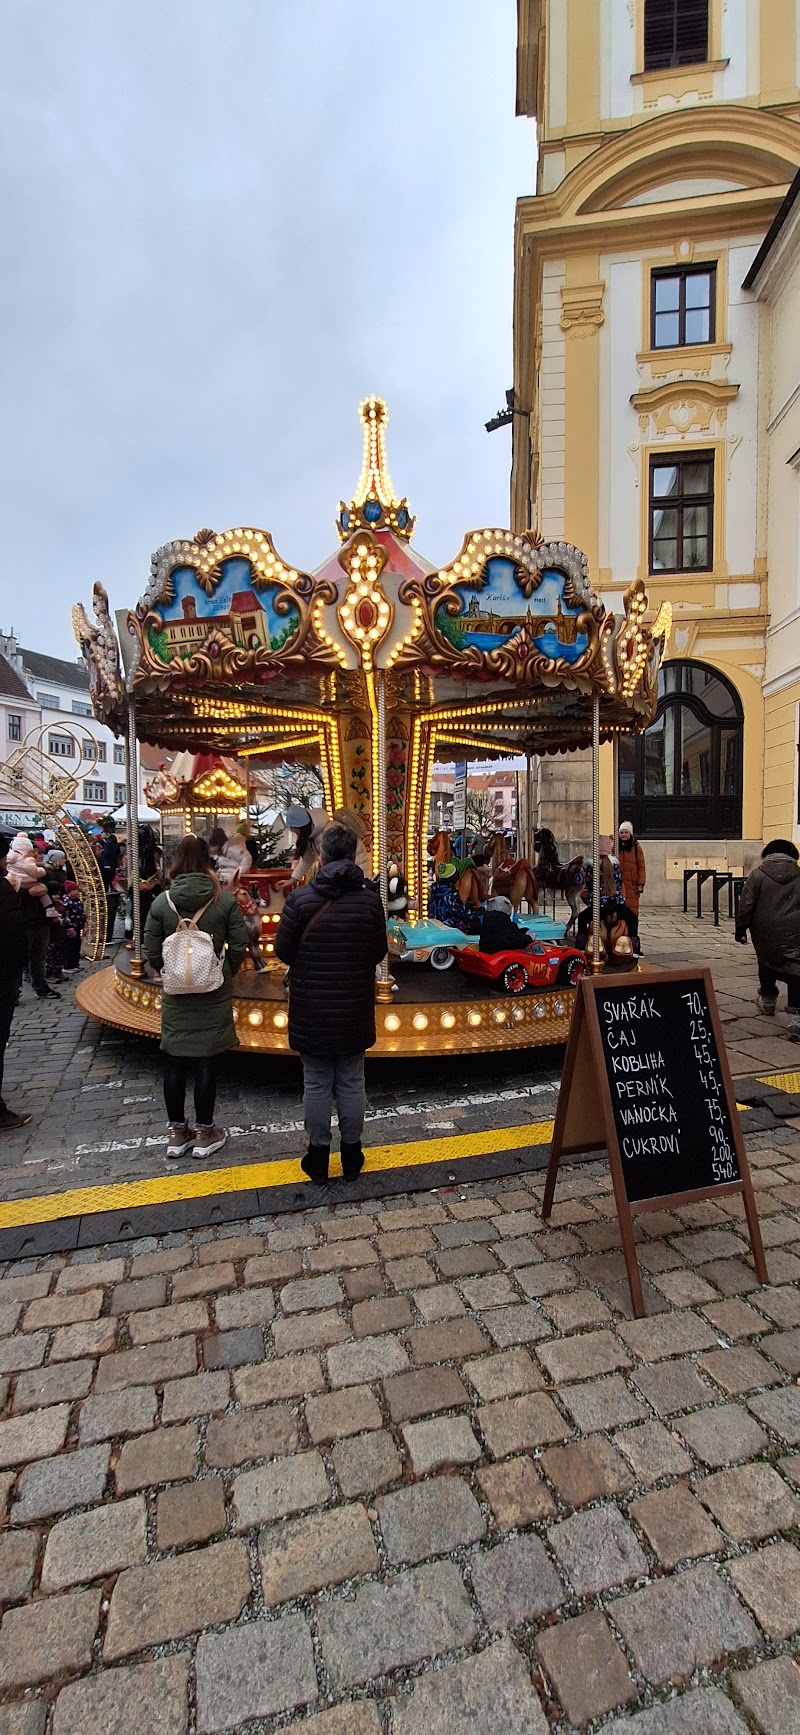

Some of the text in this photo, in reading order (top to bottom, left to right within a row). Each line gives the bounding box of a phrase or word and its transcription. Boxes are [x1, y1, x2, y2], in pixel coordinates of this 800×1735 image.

[603, 992, 661, 1023] SVAŘÁK
[607, 1026, 637, 1049] ČAJ
[612, 1051, 665, 1073] KOBLIHA
[616, 1074, 674, 1098] PERNÍK
[622, 1128, 681, 1158] CUKROVÍ
